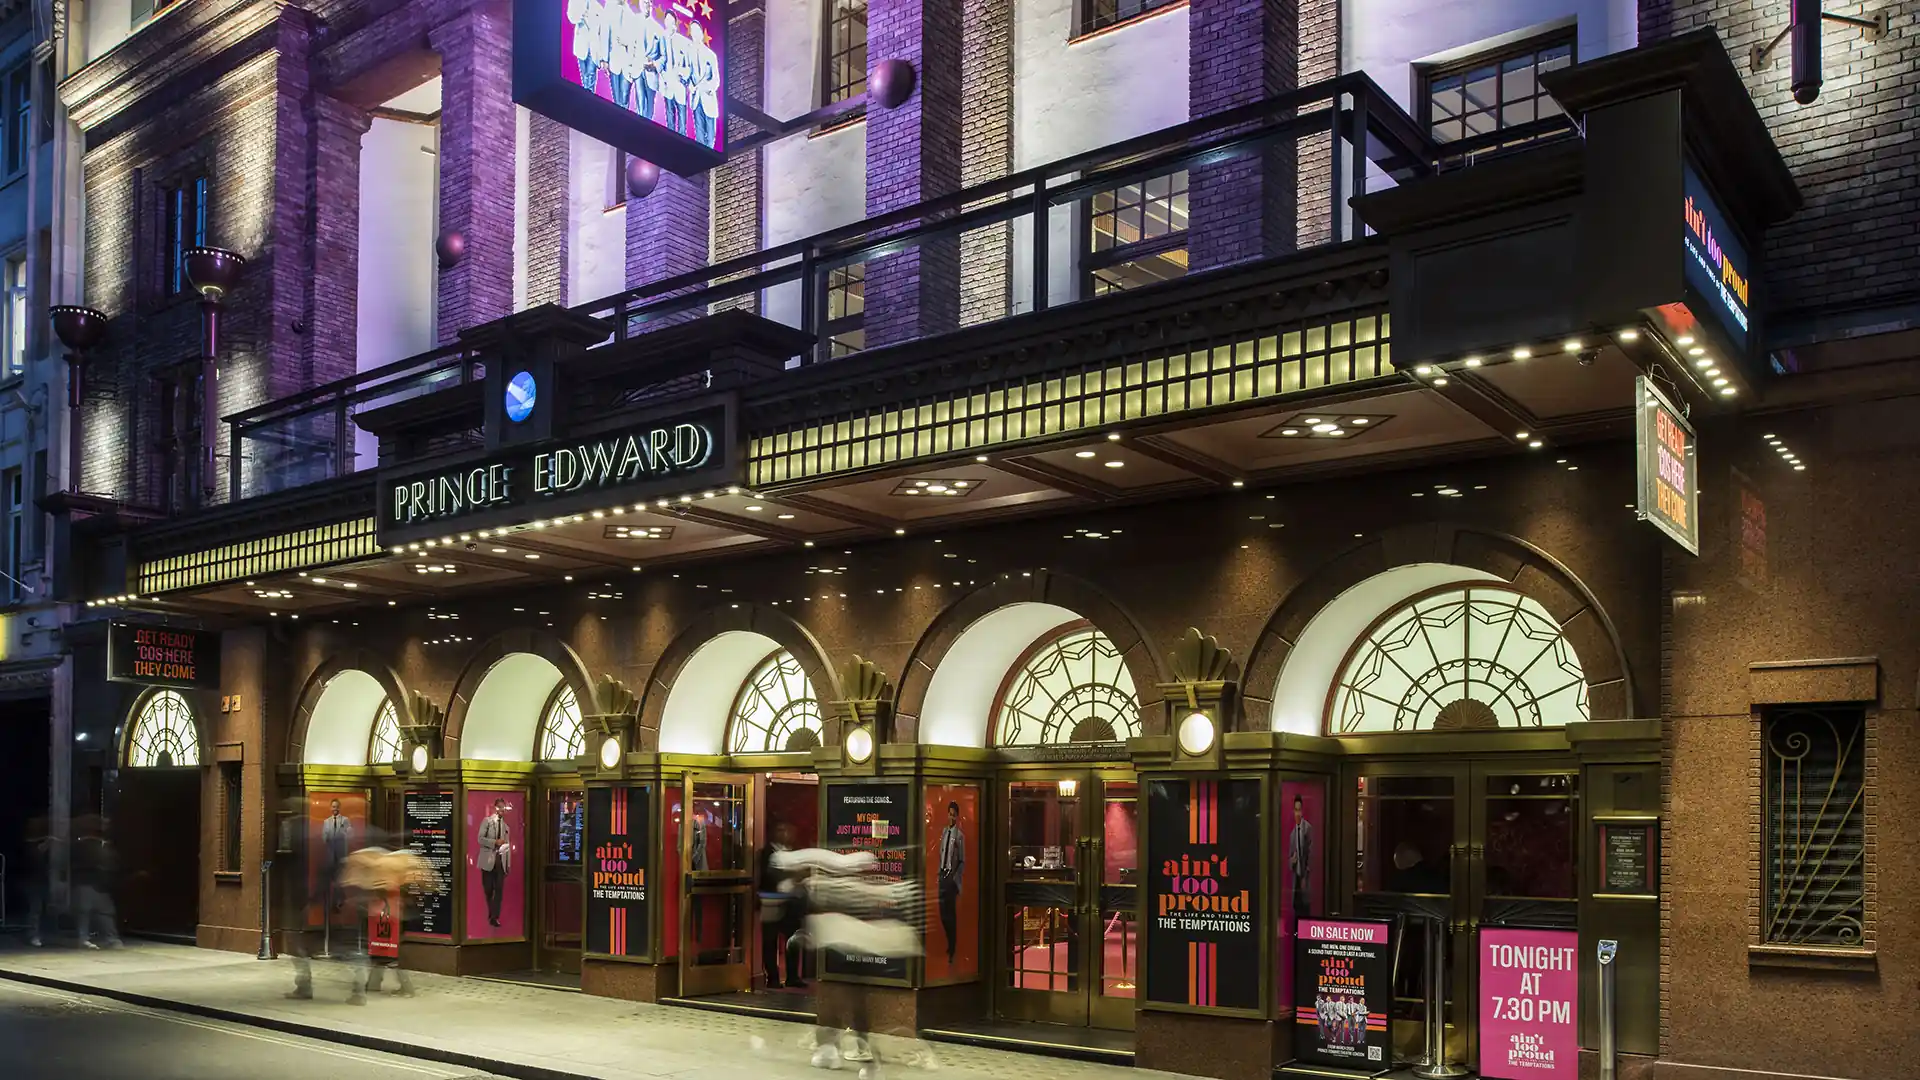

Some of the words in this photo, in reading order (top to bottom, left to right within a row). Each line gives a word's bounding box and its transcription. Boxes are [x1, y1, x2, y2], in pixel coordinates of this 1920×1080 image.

[1707, 225, 1722, 268] too
[1722, 254, 1748, 307] proud
[394, 463, 505, 520] PRINCE
[534, 423, 702, 493] EDWARD
[136, 629, 157, 645] GET
[160, 631, 195, 649] READY
[165, 648, 194, 664] HERE
[134, 661, 161, 677] THEY
[163, 663, 195, 680] COME
[843, 796, 866, 804] FEATURING
[866, 796, 874, 804] THE
[856, 812, 866, 823] MY
[836, 825, 851, 835] JUST
[851, 825, 861, 835] MY
[852, 836, 863, 847] GET
[596, 842, 633, 860] ain't
[886, 850, 906, 860] STONE
[601, 857, 628, 873] too
[890, 862, 902, 873] BEG
[1162, 853, 1230, 878] ain't
[593, 868, 645, 889] proud
[1172, 872, 1219, 895] too
[593, 889, 604, 898] THE
[605, 890, 645, 900] TEMPTATIONS
[1158, 889, 1250, 917] proud
[1157, 918, 1177, 929] THE
[1179, 919, 1251, 933] TEMPTATIONS
[1310, 925, 1324, 938] ON
[1325, 926, 1348, 940] SALE
[1350, 928, 1374, 941] NOW
[874, 956, 887, 965] MORE
[1320, 956, 1354, 969] ain't
[1489, 944, 1575, 971] TONIGHT
[1325, 966, 1349, 977] too
[1318, 974, 1365, 987] proud
[1519, 972, 1543, 996] AT
[1328, 987, 1365, 996] TEMPTATIONS
[1491, 996, 1534, 1022] 7.30
[1538, 999, 1571, 1025] PM
[1510, 1032, 1544, 1045] ain't
[1515, 1042, 1539, 1052] too
[1508, 1049, 1555, 1061] proud
[1519, 1061, 1555, 1069] TEMPTATIONS
